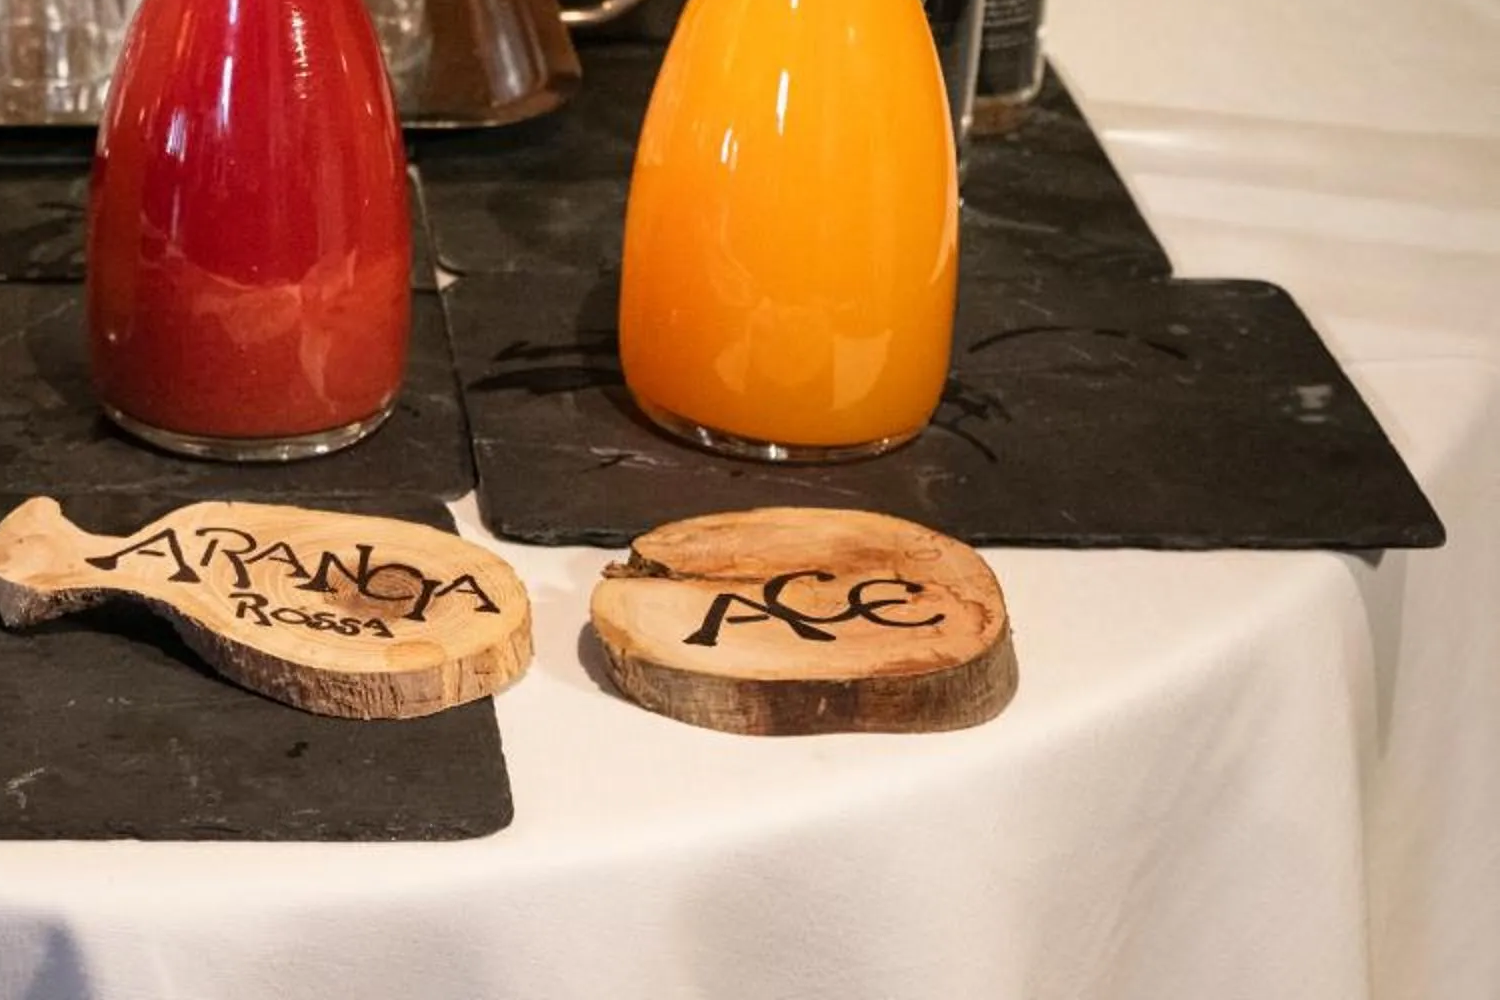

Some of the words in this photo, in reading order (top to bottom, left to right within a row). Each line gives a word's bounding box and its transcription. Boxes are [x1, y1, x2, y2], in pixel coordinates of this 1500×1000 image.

[85, 527, 500, 622] ARANCIA
[683, 569, 945, 647] ACE
[229, 592, 394, 638] ROSSA
